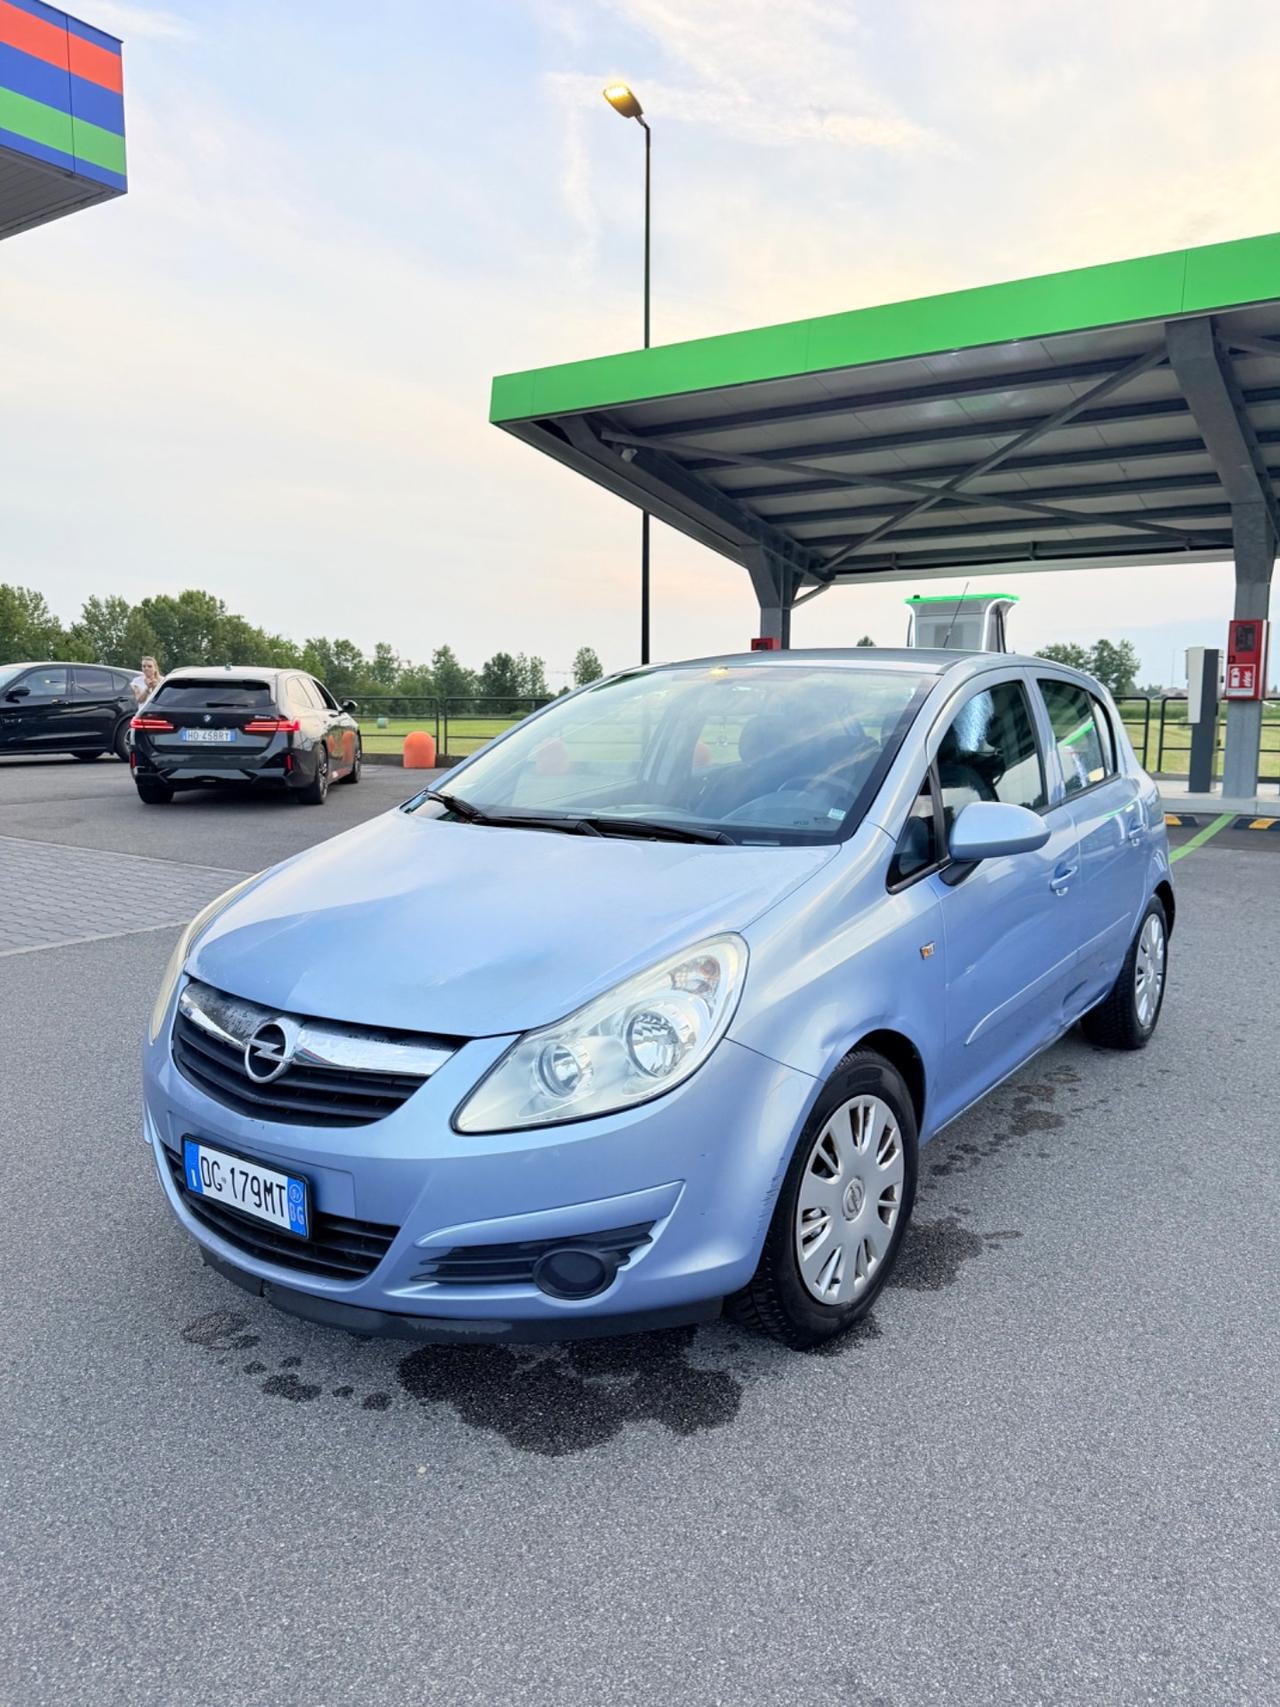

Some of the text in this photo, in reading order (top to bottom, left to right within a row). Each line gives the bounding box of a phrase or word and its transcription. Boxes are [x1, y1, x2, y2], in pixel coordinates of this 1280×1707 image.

[200, 1156, 286, 1218] DG 179MT
[289, 1202, 305, 1225] BG
